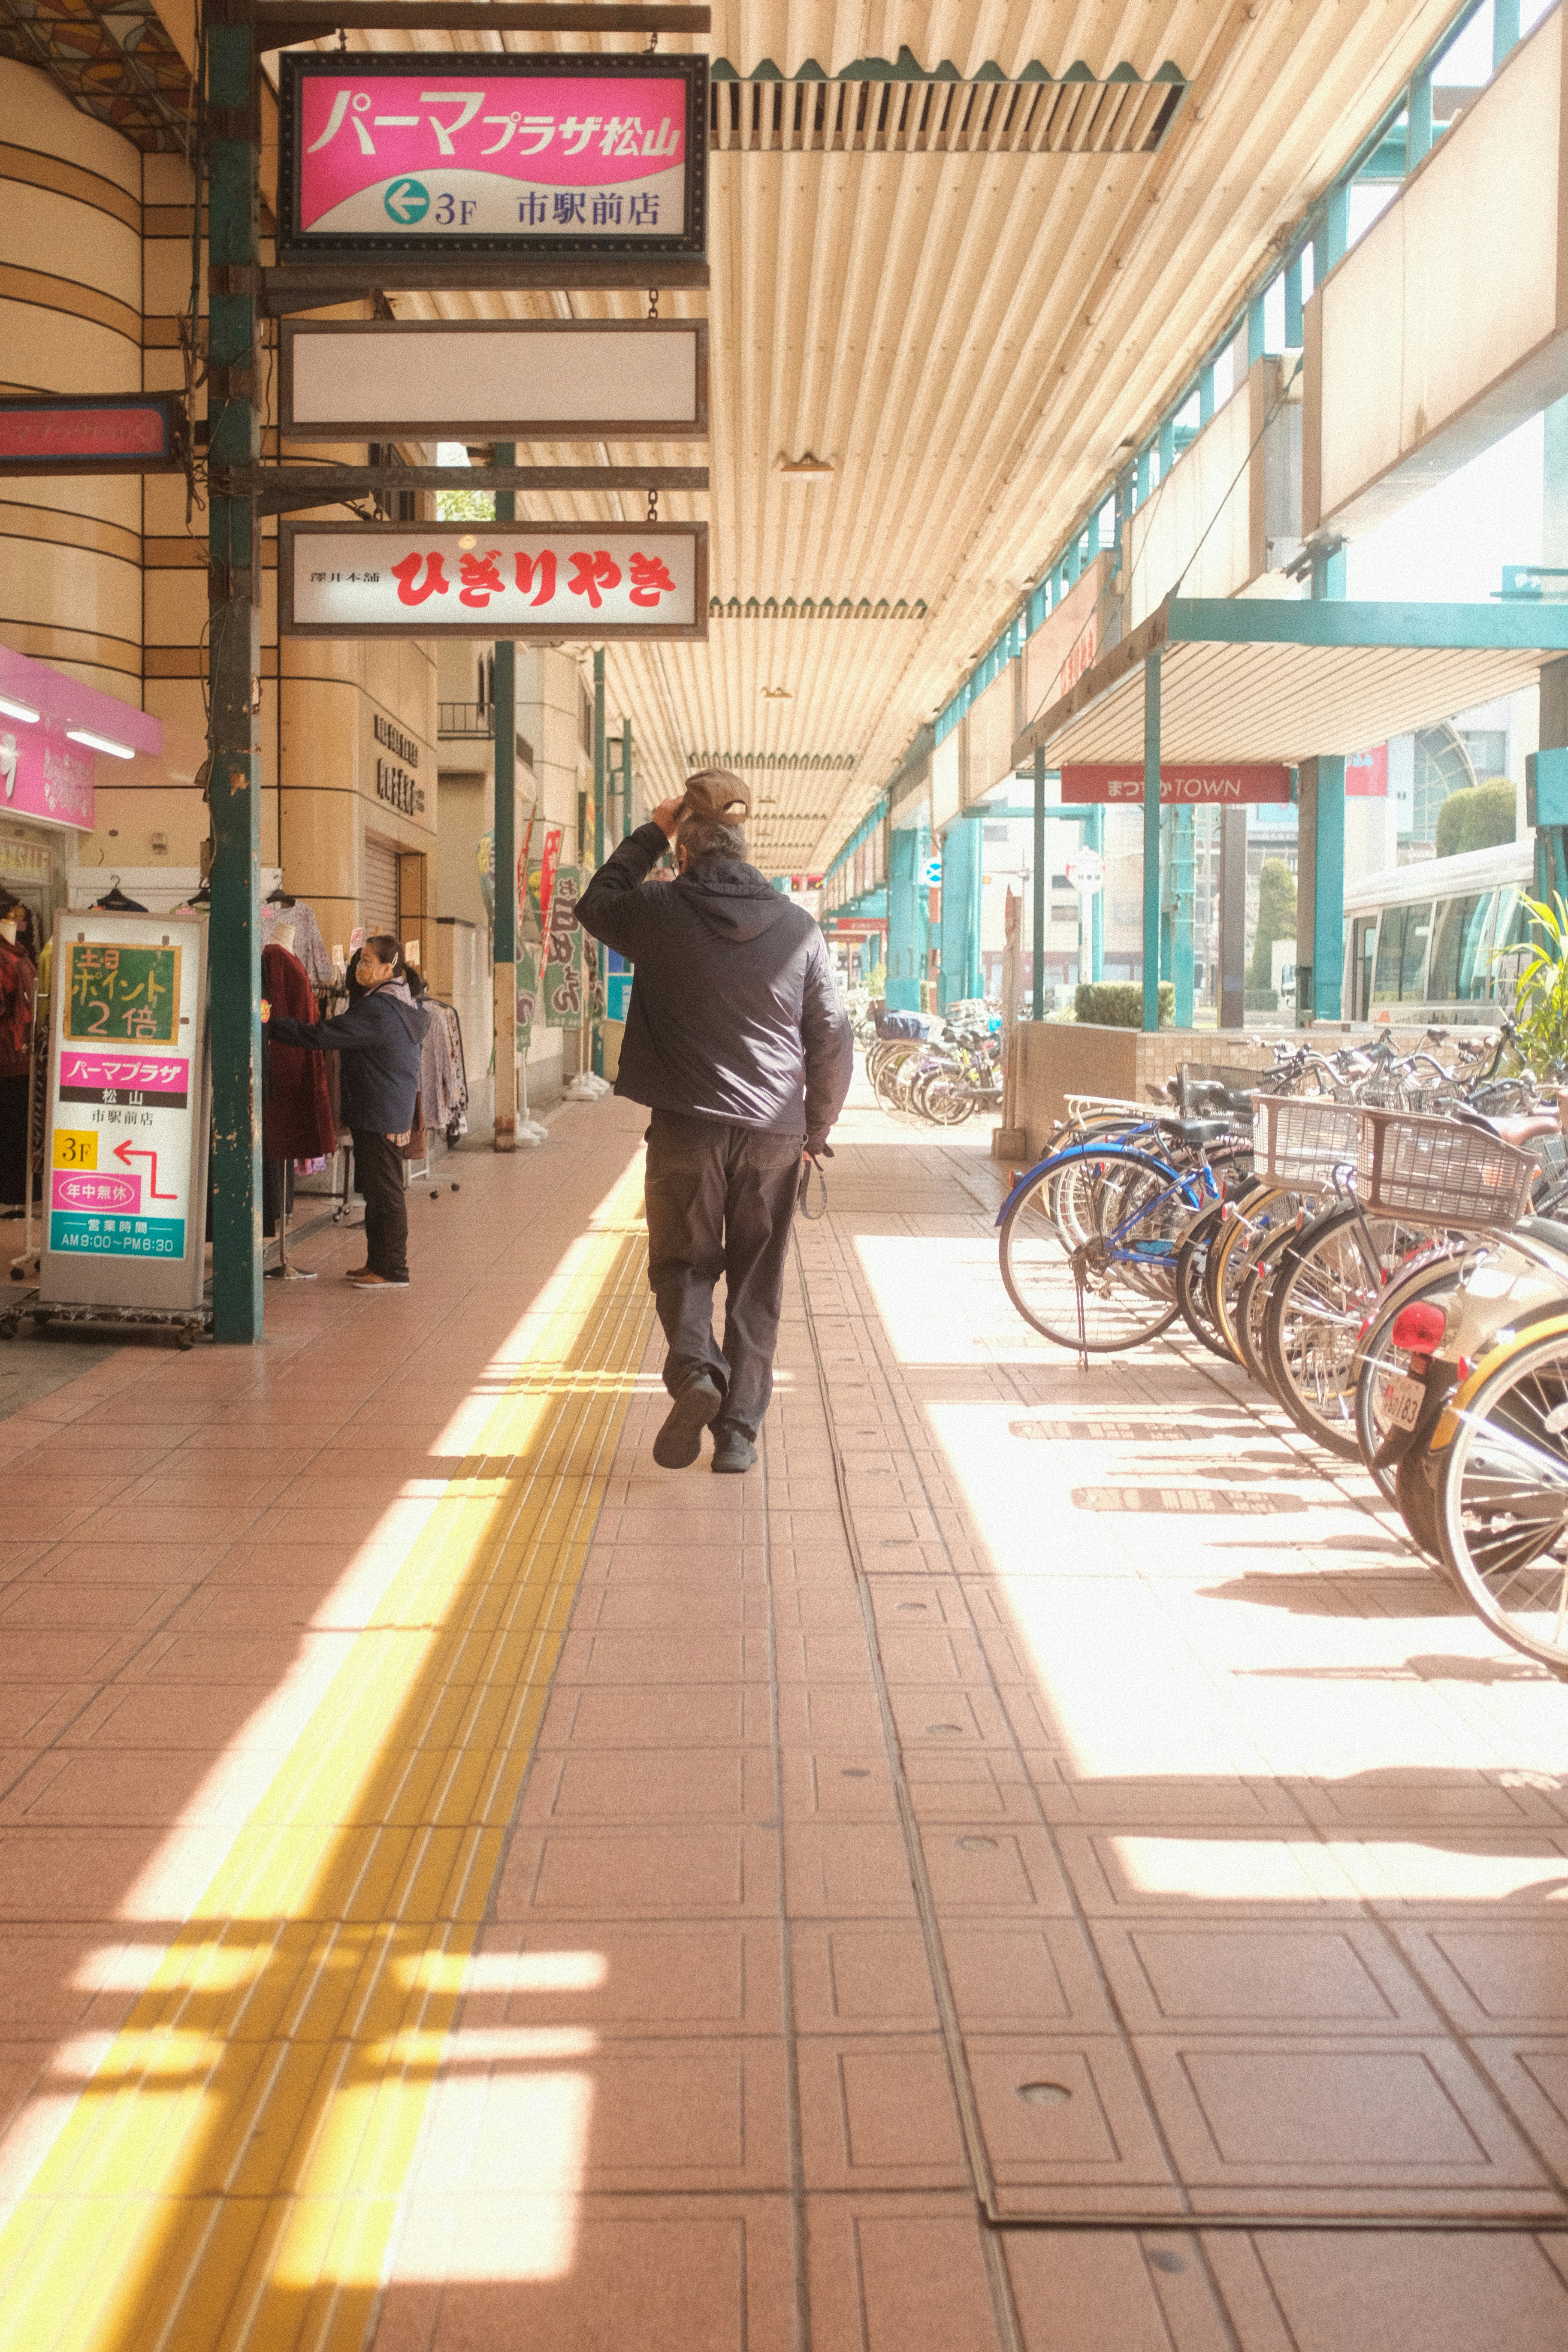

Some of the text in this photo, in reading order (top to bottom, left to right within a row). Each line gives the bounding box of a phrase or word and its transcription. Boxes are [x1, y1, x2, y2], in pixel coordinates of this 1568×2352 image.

[306, 90, 682, 157] パーマプラザ松山
[435, 191, 660, 226] 3F 市駅前店
[391, 549, 676, 609] ひぎりやき
[1108, 779, 1241, 797] まつかTOWN
[72, 969, 166, 1003] ポイント
[88, 1001, 157, 1039] 2倍
[67, 1060, 183, 1084] パーマプラザ
[103, 1088, 143, 1106] 松山
[92, 1109, 154, 1126] 市駅前店
[62, 1137, 91, 1162] 3F
[67, 1183, 127, 1201] 年中無休
[88, 1218, 148, 1234] 営業時間
